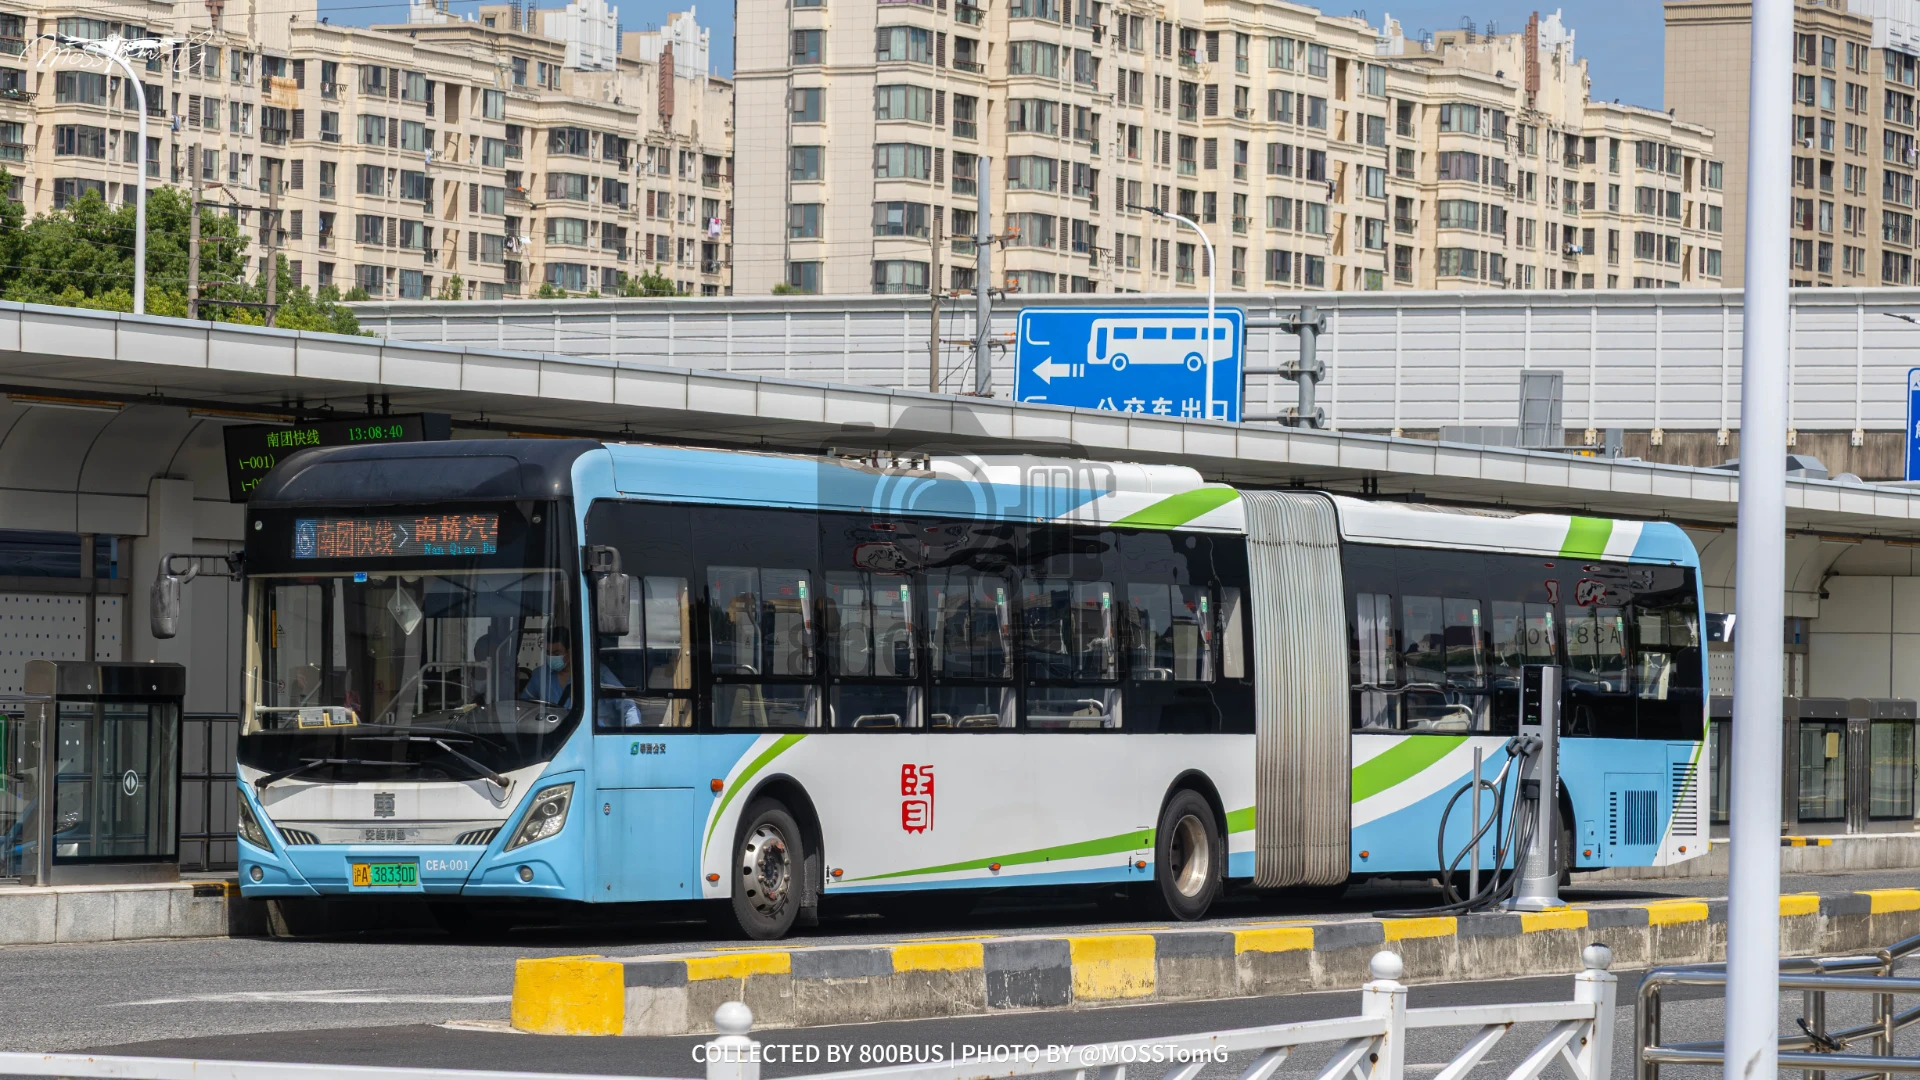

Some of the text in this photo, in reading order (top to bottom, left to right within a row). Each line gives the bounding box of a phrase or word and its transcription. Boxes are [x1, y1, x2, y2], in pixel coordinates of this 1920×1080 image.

[266, 425, 403, 448] 南团快线 13:08:40
[316, 520, 394, 557] 南团快线
[424, 543, 444, 555] Nan
[450, 543, 476, 556] Qiao
[426, 859, 469, 871] CEA-001
